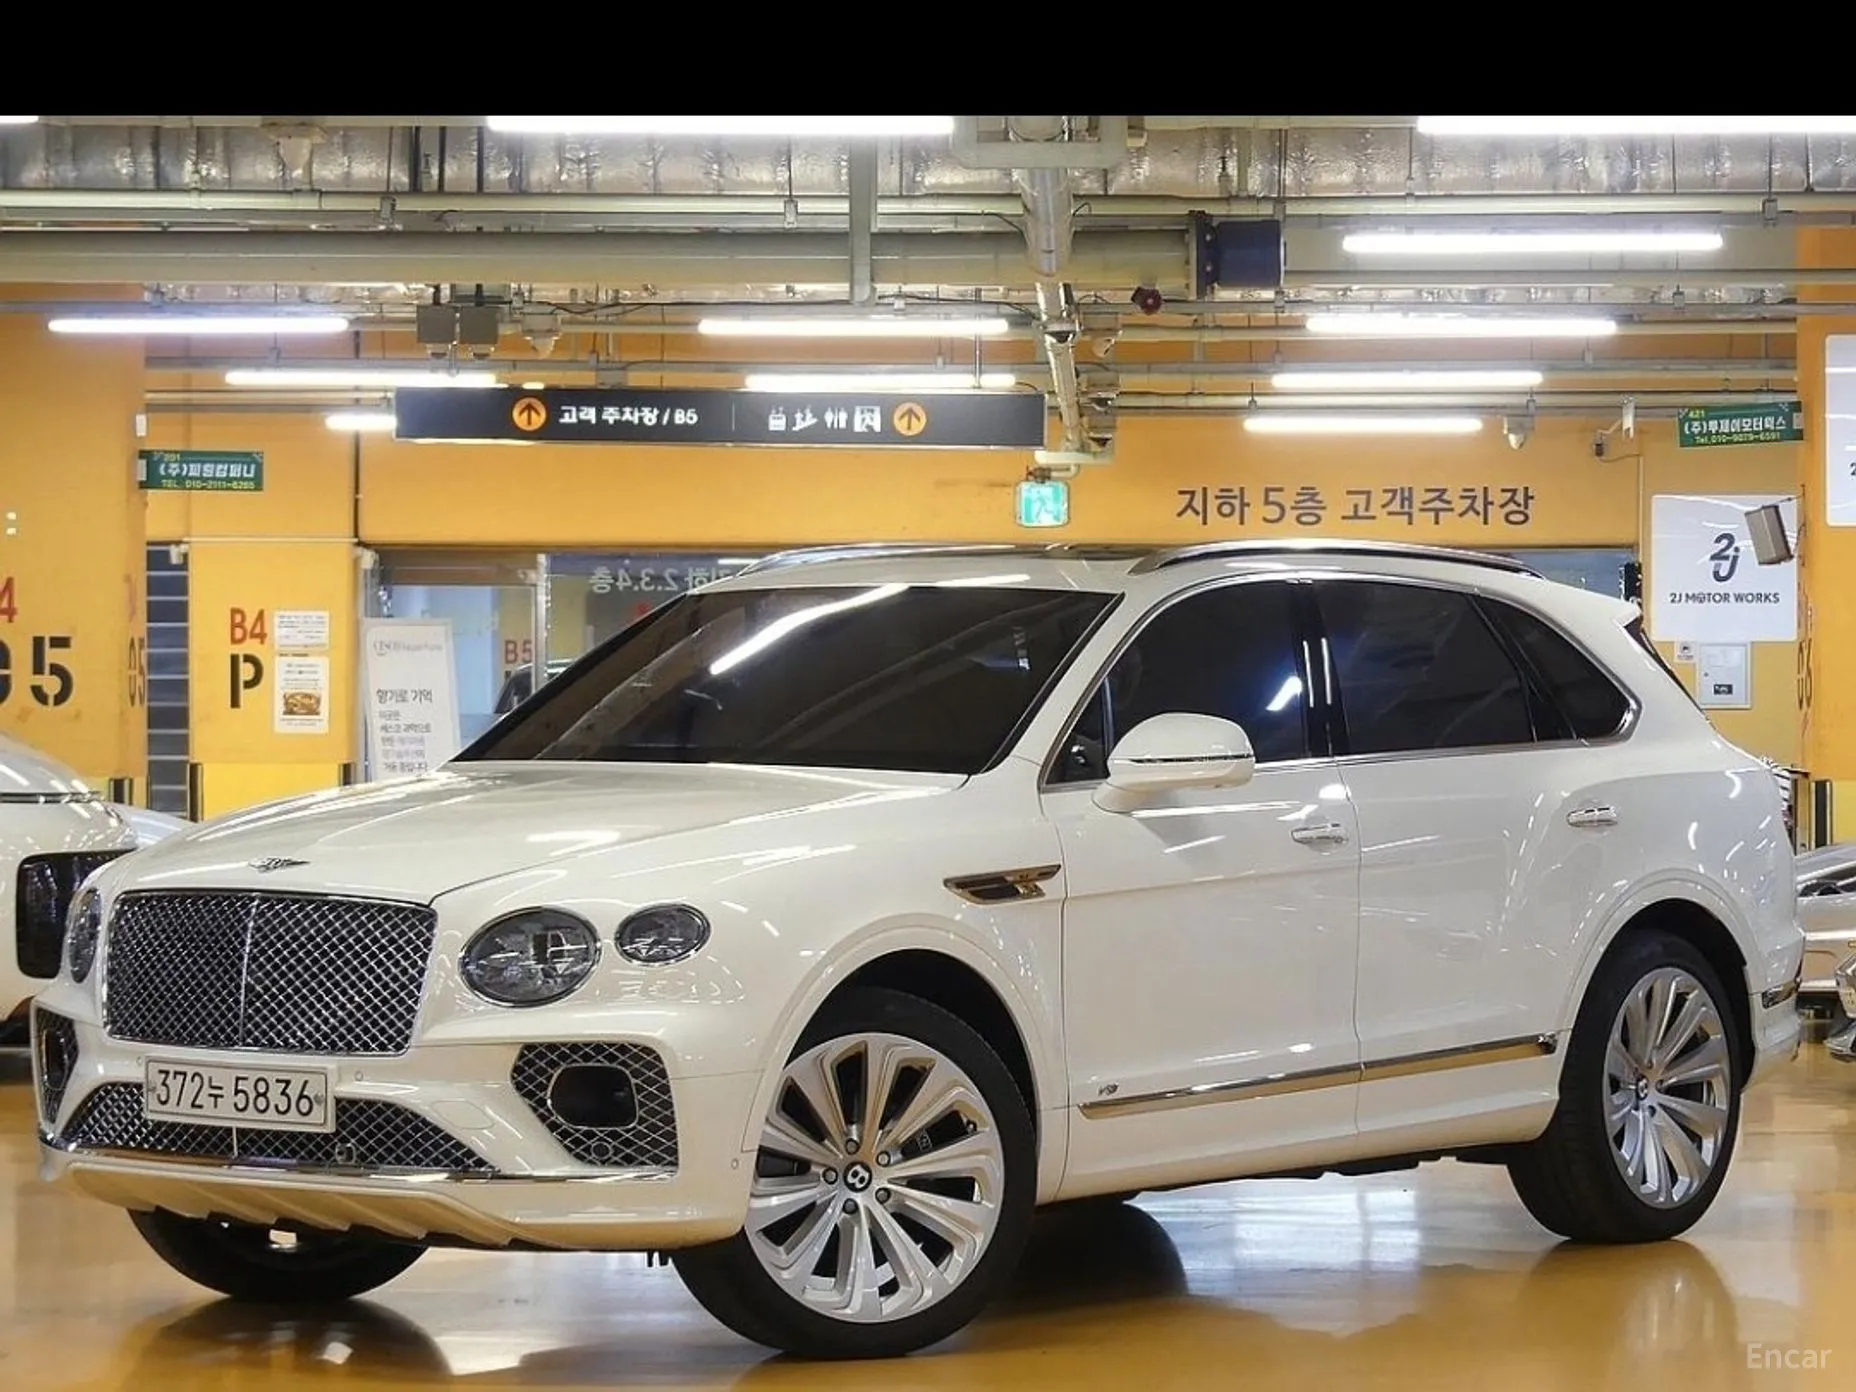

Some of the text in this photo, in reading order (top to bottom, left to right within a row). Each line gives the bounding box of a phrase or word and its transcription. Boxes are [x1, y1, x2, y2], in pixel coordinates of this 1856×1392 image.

[559, 405, 597, 424] 고객
[602, 406, 660, 426] 주차장
[674, 409, 698, 425] B5
[1176, 486, 1535, 526] 지하 5층 고객주차장
[1669, 592, 1683, 604] 2J
[1734, 592, 1780, 604] WORKS
[230, 607, 268, 645] B4
[230, 653, 264, 709] P
[156, 1068, 314, 1117] 372누 5836
